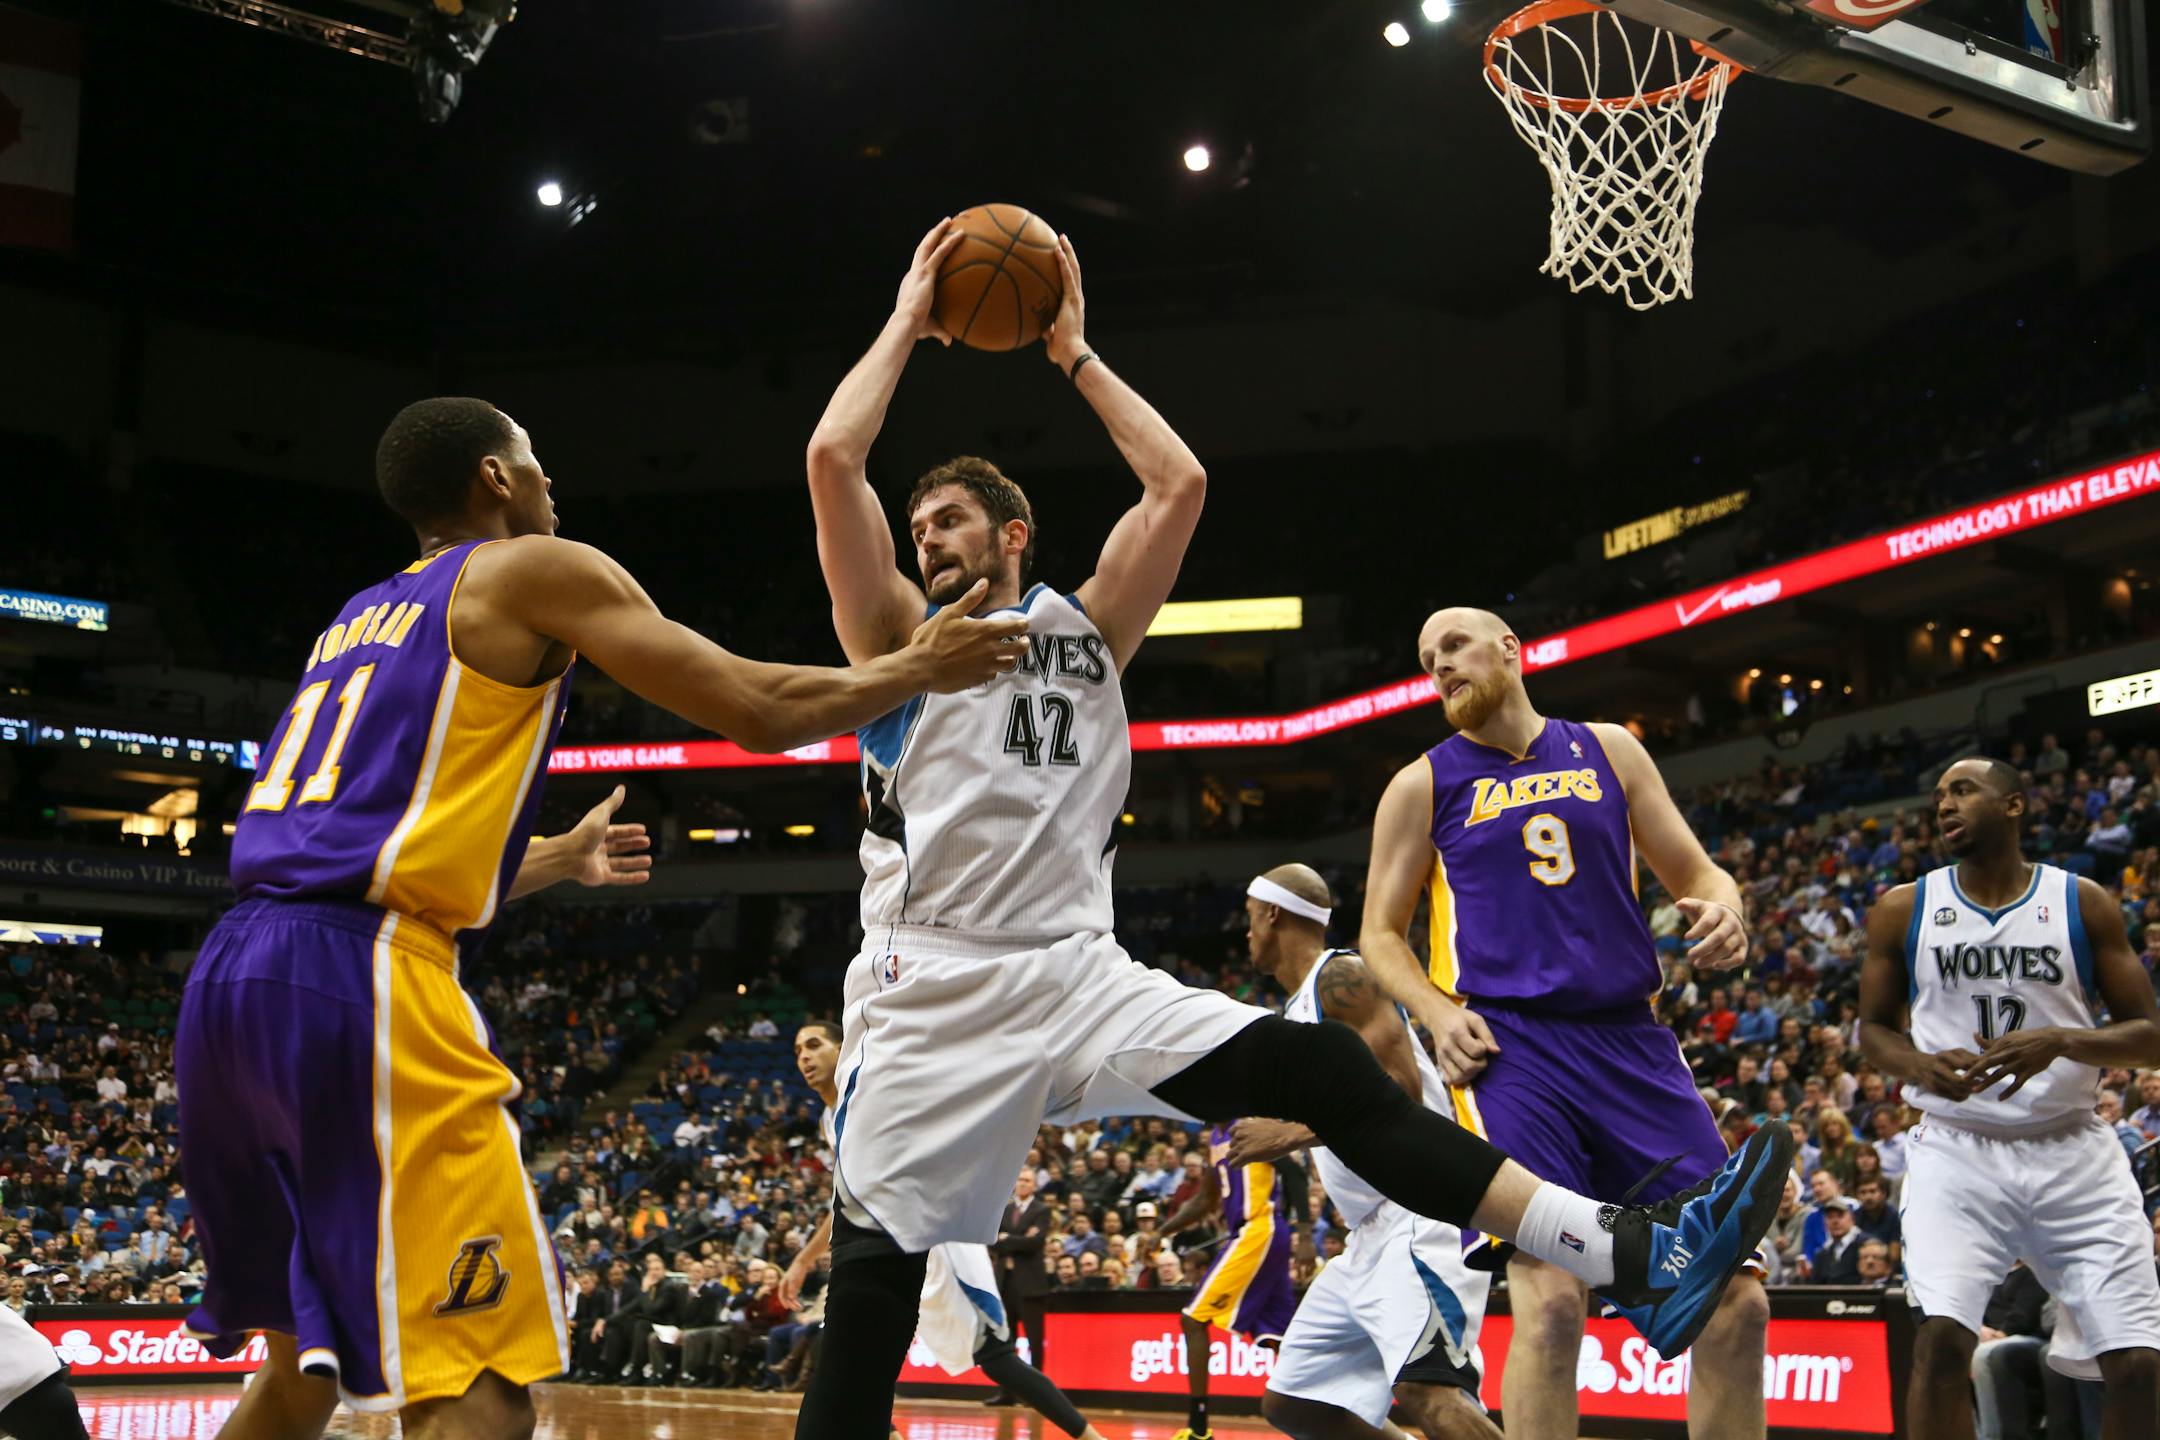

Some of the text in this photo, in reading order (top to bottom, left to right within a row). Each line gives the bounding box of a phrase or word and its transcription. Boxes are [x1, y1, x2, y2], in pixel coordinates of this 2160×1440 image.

[1886, 455, 2160, 560] TECHNOLOGY THAT ELEVA
[0, 594, 105, 621] CASINO.COM
[1000, 631, 1108, 687] LVES
[2, 726, 18, 741] 5
[244, 662, 376, 814] 11
[1003, 692, 1081, 767] 42
[1161, 722, 1279, 745] TECHNOLOGY
[588, 748, 634, 768] YOUR
[1464, 768, 1603, 828] LAKERS
[66, 859, 135, 881] Casino
[139, 864, 178, 883] VIP
[1522, 813, 1576, 886] 9
[1931, 943, 2064, 990] WOLVES
[1130, 1332, 1174, 1382] get
[1208, 1341, 1228, 1376] a
